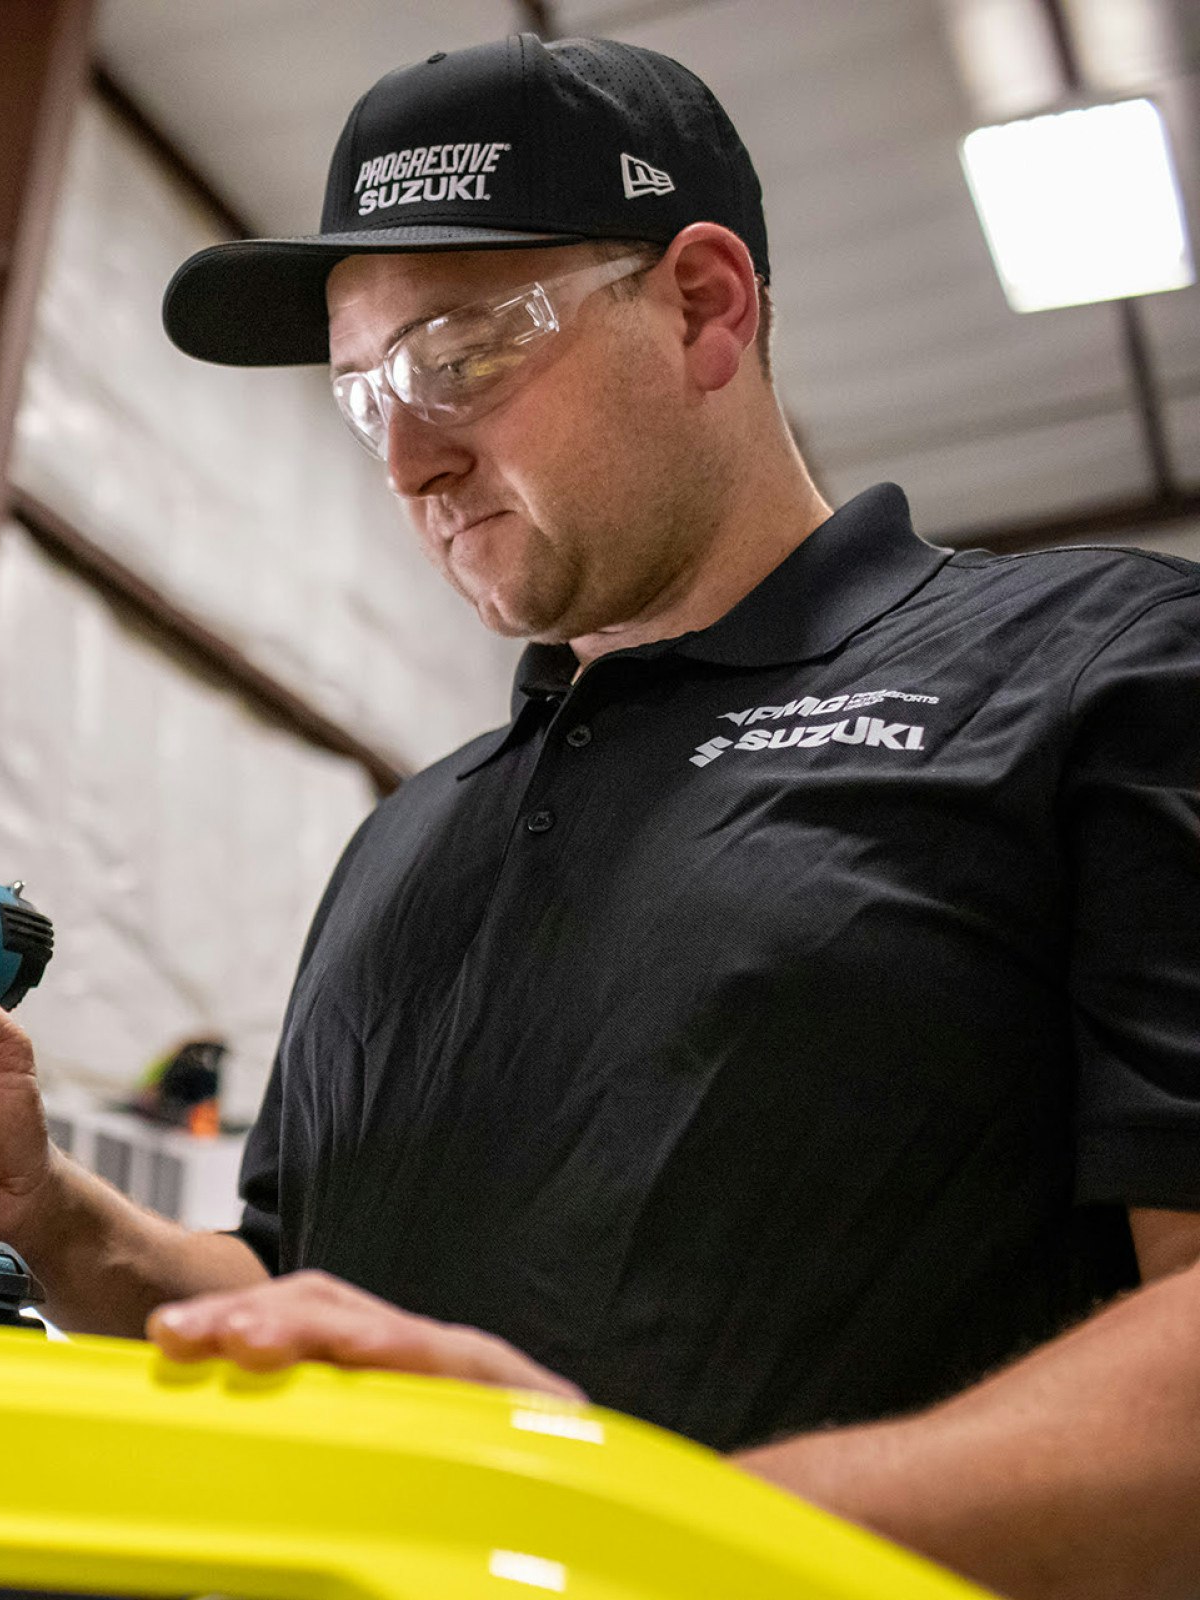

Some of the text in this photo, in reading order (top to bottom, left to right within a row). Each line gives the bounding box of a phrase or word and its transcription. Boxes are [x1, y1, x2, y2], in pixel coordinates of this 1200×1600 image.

[354, 143, 505, 194] PROGRESSIVE
[358, 174, 488, 216] SUZUKI
[734, 716, 924, 751] SUZUKI
